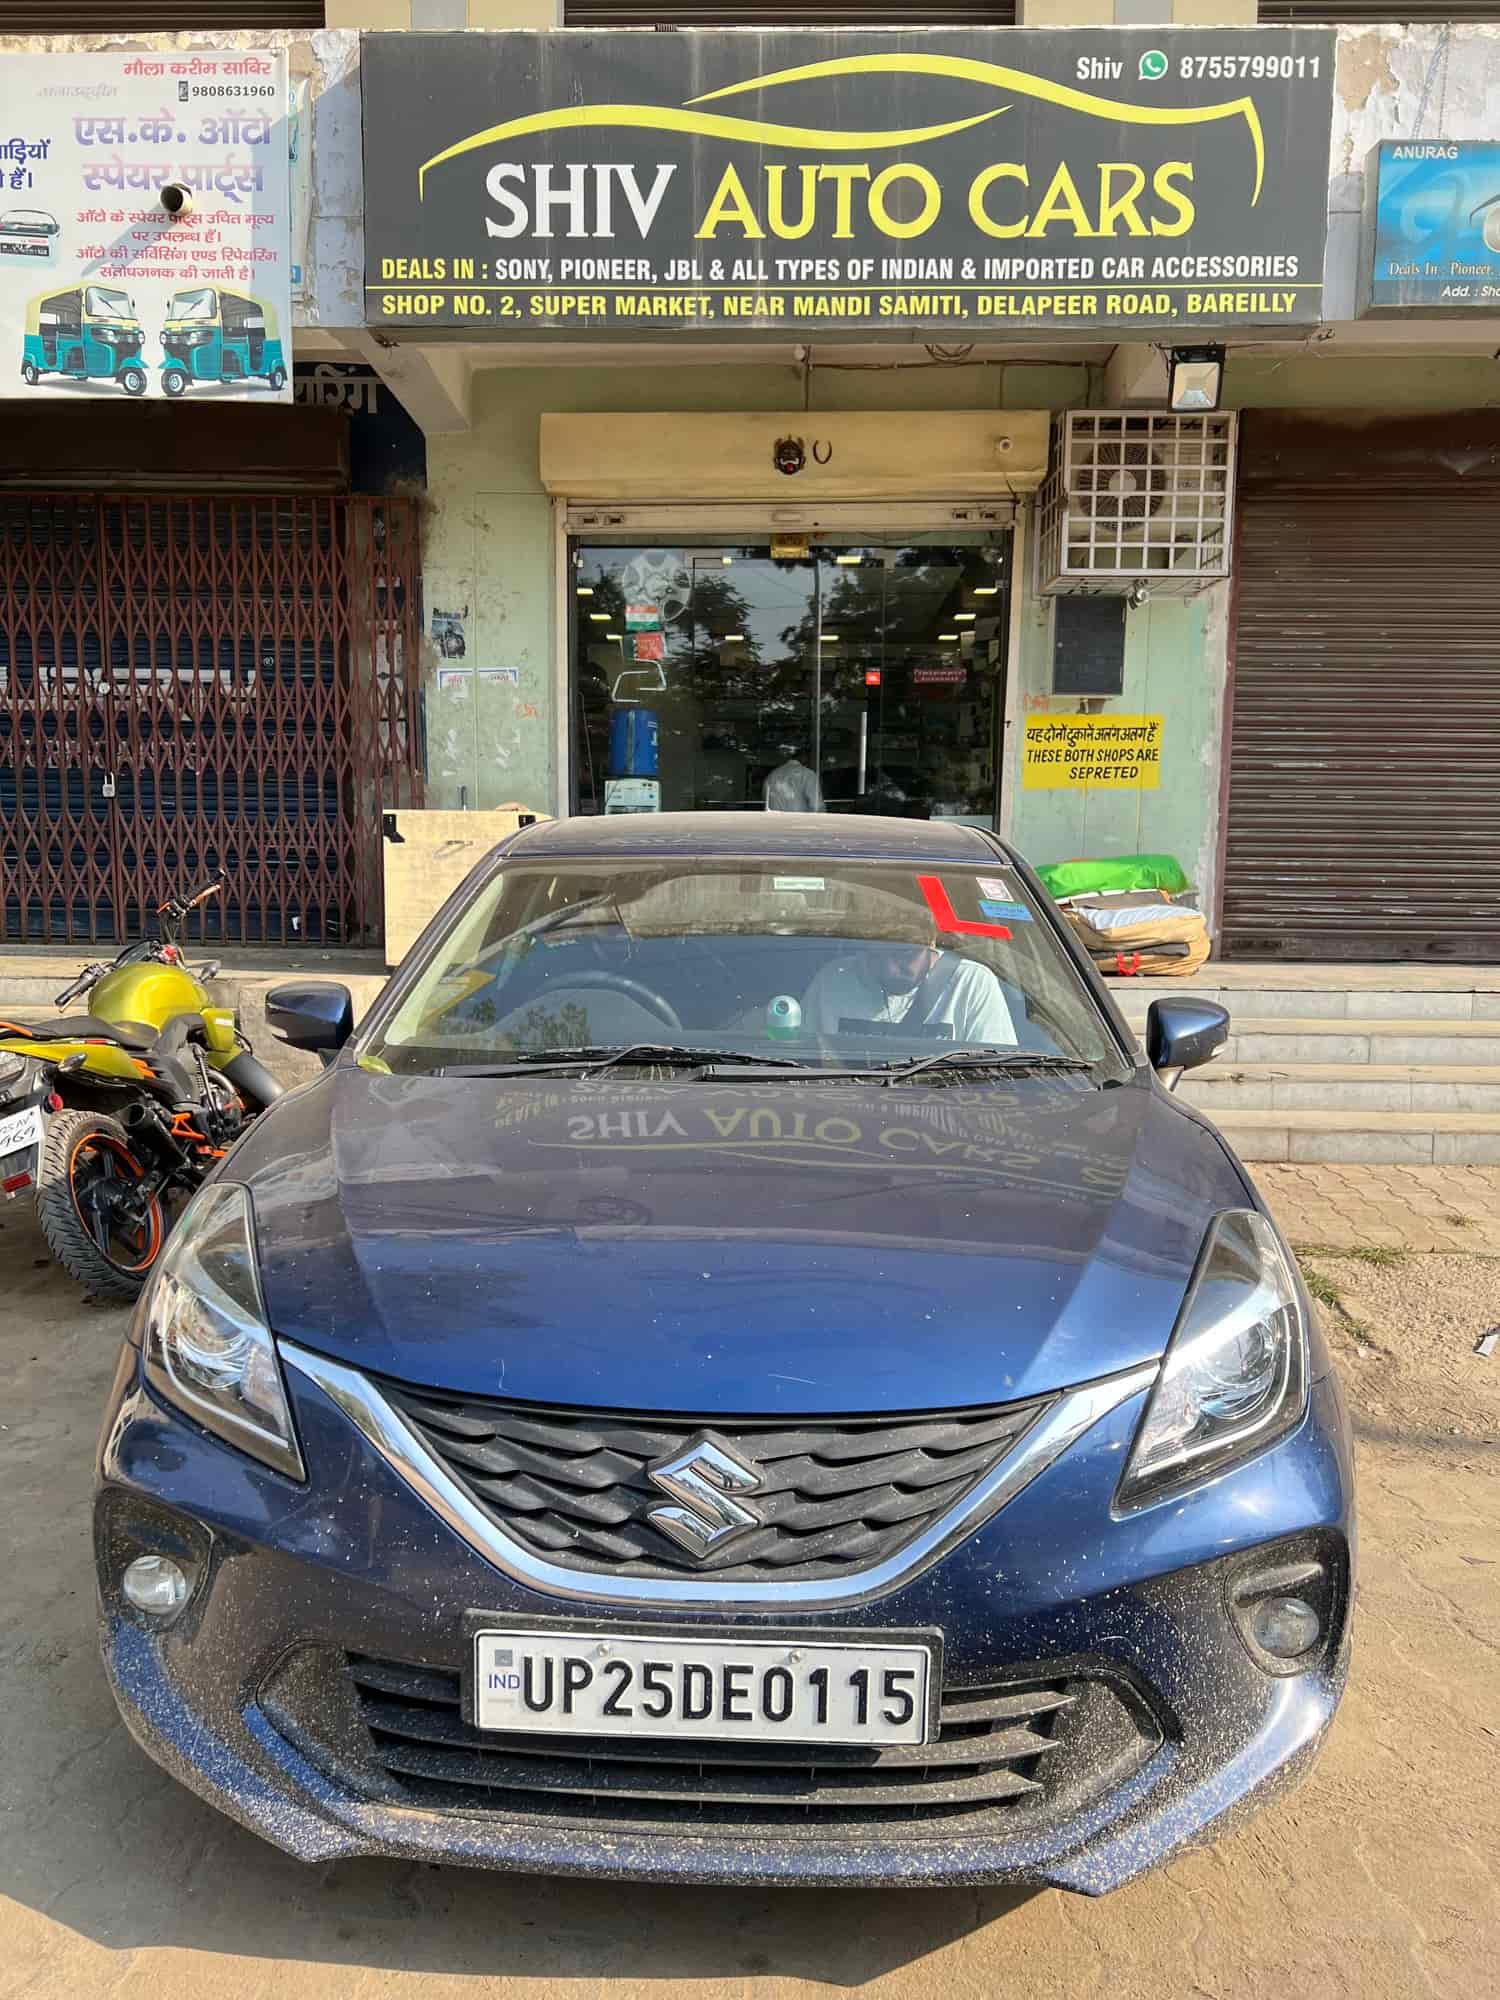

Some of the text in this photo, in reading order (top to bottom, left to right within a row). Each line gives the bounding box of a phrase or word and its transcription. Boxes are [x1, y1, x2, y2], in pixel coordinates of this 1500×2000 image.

[170, 57, 216, 76] करीम
[1077, 56, 1320, 80] Shiv 8755799011
[192, 86, 274, 97] 9808631960
[199, 109, 273, 145] ऑटो
[0, 138, 51, 165] ाड़ियों
[1392, 146, 1459, 160] ANURAG
[82, 154, 170, 191] स्पेयर
[485, 161, 1195, 239] SHIV AUTO CARS
[110, 210, 124, 223] के
[131, 231, 149, 241] पर
[110, 245, 128, 260] की
[179, 265, 198, 279] की
[201, 266, 235, 280] जाती
[382, 259, 446, 280] DEALS
[454, 259, 475, 280] IN
[495, 259, 553, 284] SONY,
[560, 259, 657, 284] PIONEER,
[664, 259, 703, 281] JBL
[710, 259, 726, 281] &
[732, 259, 769, 281] ALL
[775, 259, 840, 281] TYPES
[847, 259, 875, 281] OF
[881, 258, 954, 280] INDIAN
[961, 258, 976, 279] &
[984, 258, 1095, 280] IMPORTED
[1102, 257, 1144, 279] CAR
[1151, 256, 1299, 279] ACCESSORIES
[382, 293, 1297, 320] SHOP NO. 2, SUPER MARKET, NEAR MANDI SAMITI, DELAPEER ROAD, BAREILLY
[1026, 727, 1043, 743] यह
[1027, 748, 1160, 763] THESE BOTH SHOPS ARE
[1069, 766, 1139, 780] SEPRETED
[488, 1655, 917, 1726] IND UP25DE0115
